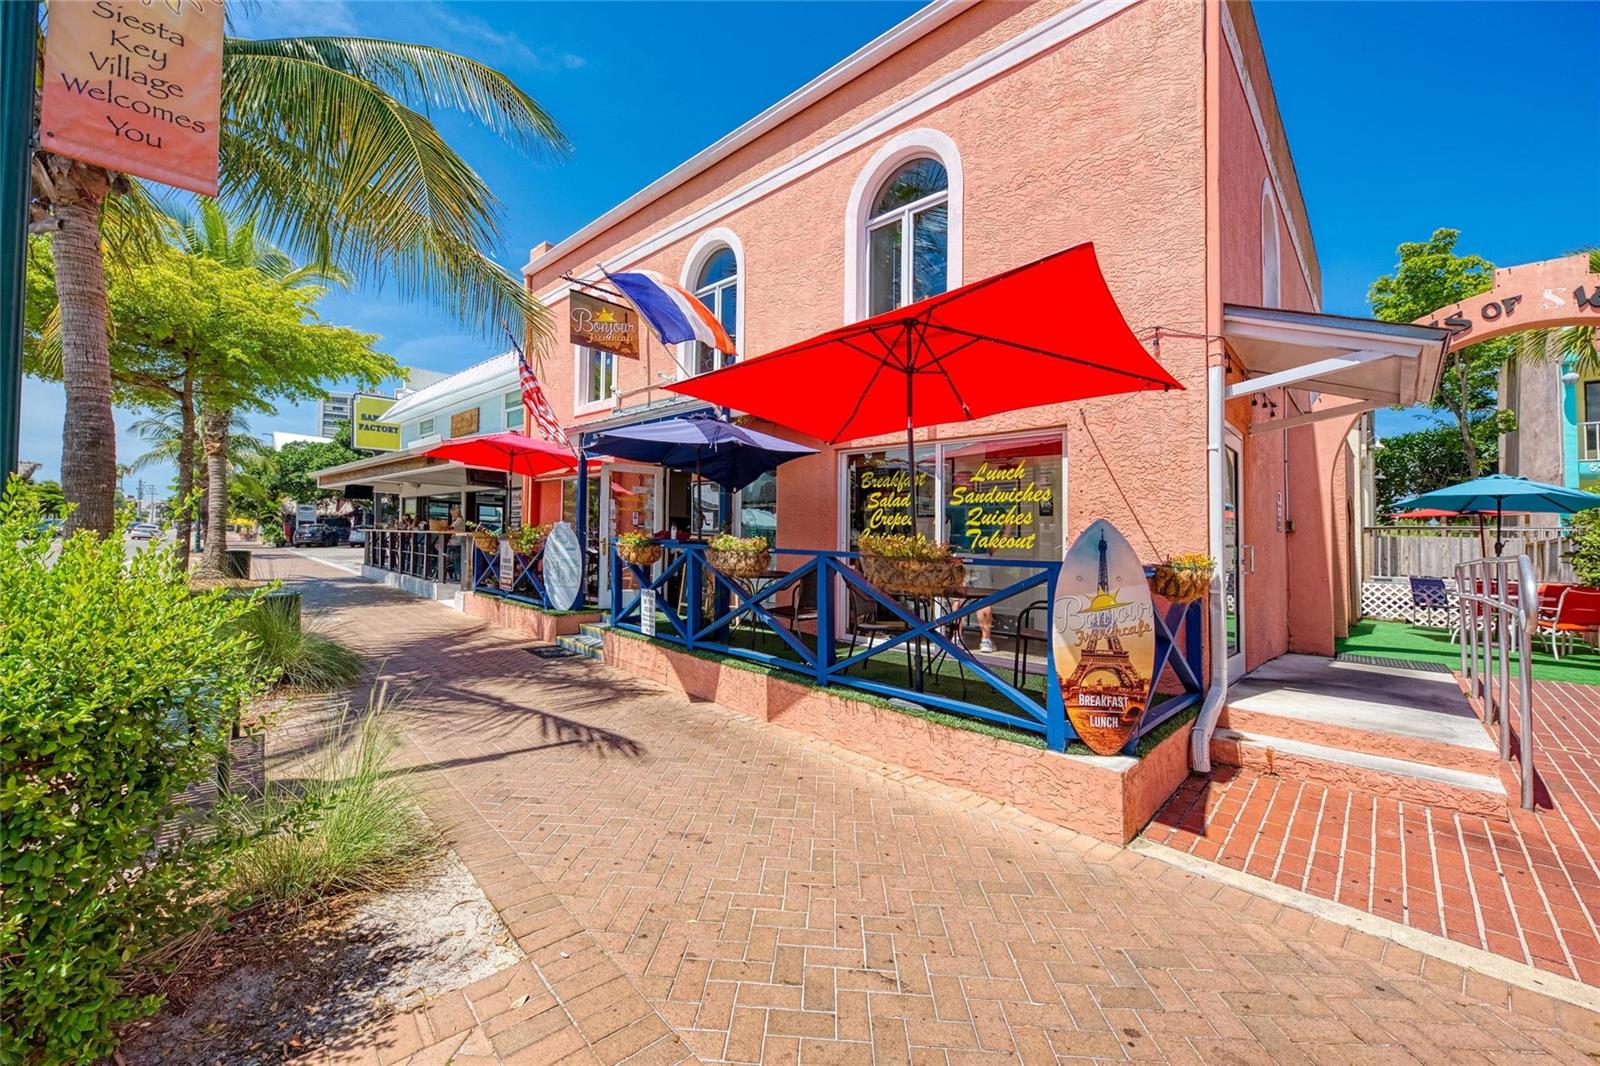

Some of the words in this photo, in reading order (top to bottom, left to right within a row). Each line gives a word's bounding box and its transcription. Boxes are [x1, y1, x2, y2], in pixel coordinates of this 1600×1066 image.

[92, 1, 185, 47] Siesta
[110, 30, 168, 71] Key
[89, 52, 184, 100] Village
[61, 73, 206, 134] Welcomes
[106, 116, 162, 149] You
[1481, 295, 1522, 320] OF
[571, 307, 634, 339] Bonjour
[358, 423, 399, 434] FACTORY
[970, 460, 1026, 483] Lunch
[867, 491, 911, 510] Salad
[950, 482, 1052, 506] Sandwiches
[965, 505, 1034, 528] Quiches
[965, 528, 1036, 550] Takeout
[1055, 595, 1154, 636] Bonjour
[1078, 694, 1129, 709] BREAKFAST
[1089, 715, 1119, 728] LUNCH
